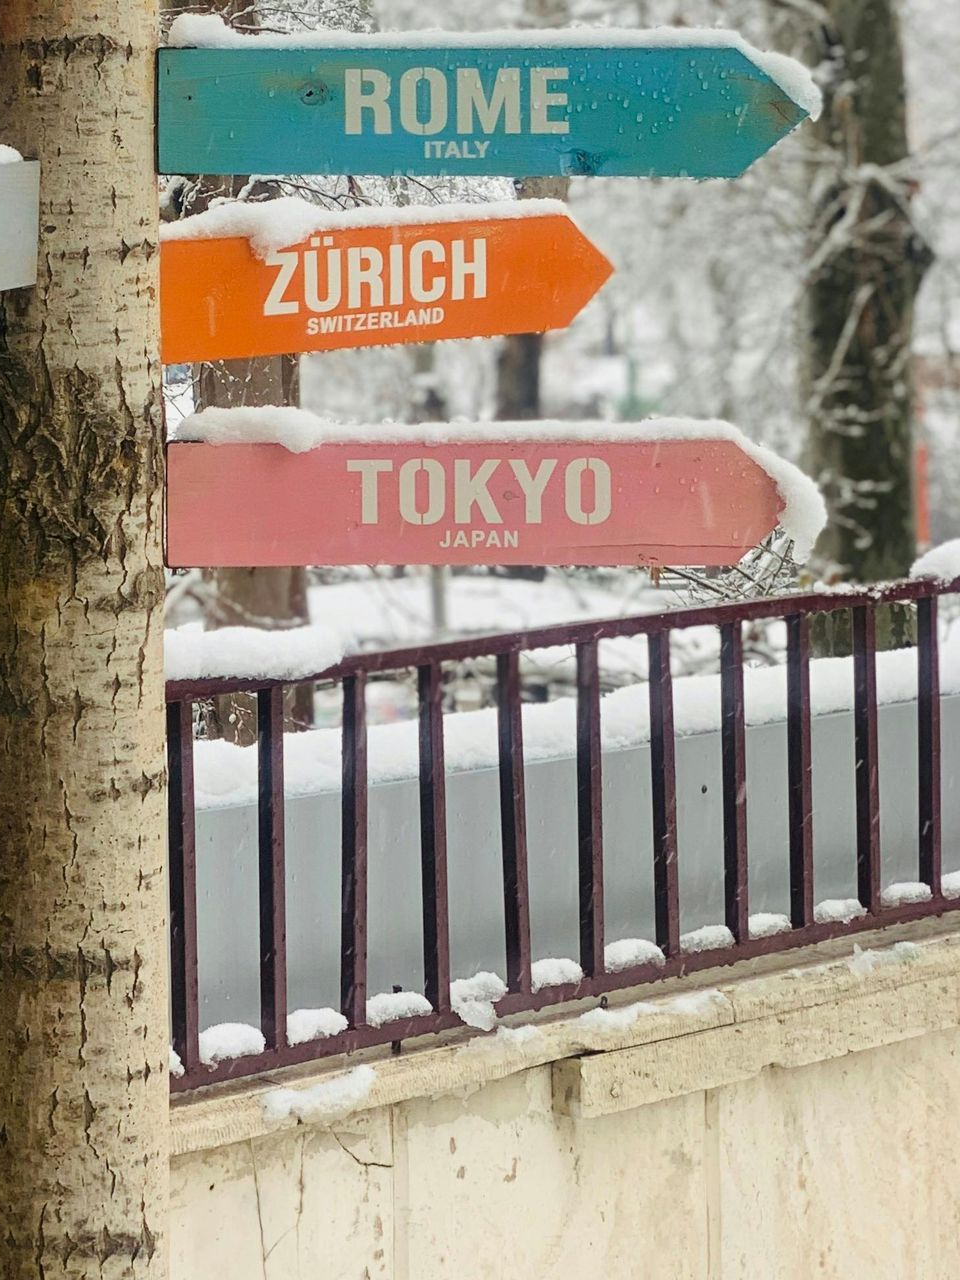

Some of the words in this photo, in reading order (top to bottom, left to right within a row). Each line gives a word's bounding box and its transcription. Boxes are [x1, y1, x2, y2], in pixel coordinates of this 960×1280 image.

[344, 67, 569, 136] ROME
[424, 140, 489, 159] ITALY
[264, 236, 487, 316] ZÜRICH
[306, 307, 444, 335] SWITZERLAND
[347, 457, 611, 525] TOKYO
[440, 530, 519, 549] JAPAN
